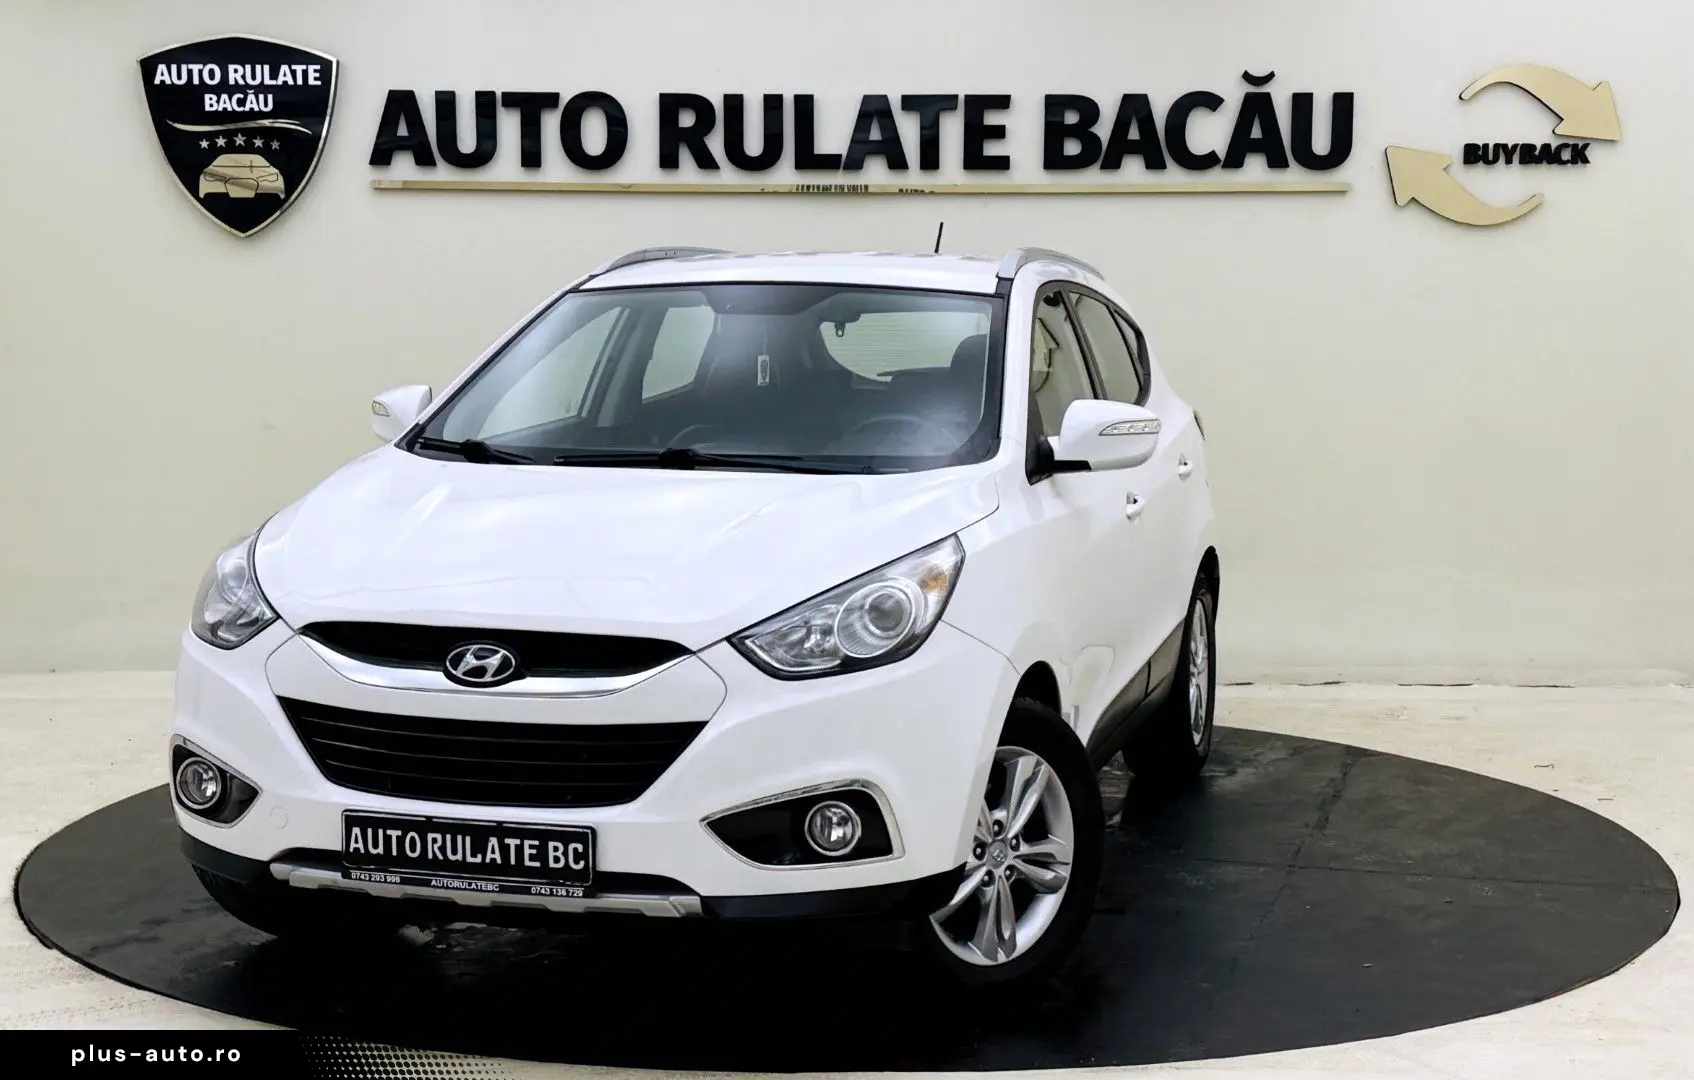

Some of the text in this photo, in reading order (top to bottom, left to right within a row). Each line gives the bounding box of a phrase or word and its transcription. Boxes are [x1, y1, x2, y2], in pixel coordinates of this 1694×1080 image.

[154, 63, 322, 86] AUTO RULATE
[204, 90, 274, 112] BACĂU
[369, 71, 1354, 171] AUTO RULATE BACĂU
[1463, 143, 1591, 165] BUYBACK
[350, 827, 585, 870] AUTO RULATE BC
[430, 879, 500, 891] AUTORULATEBC
